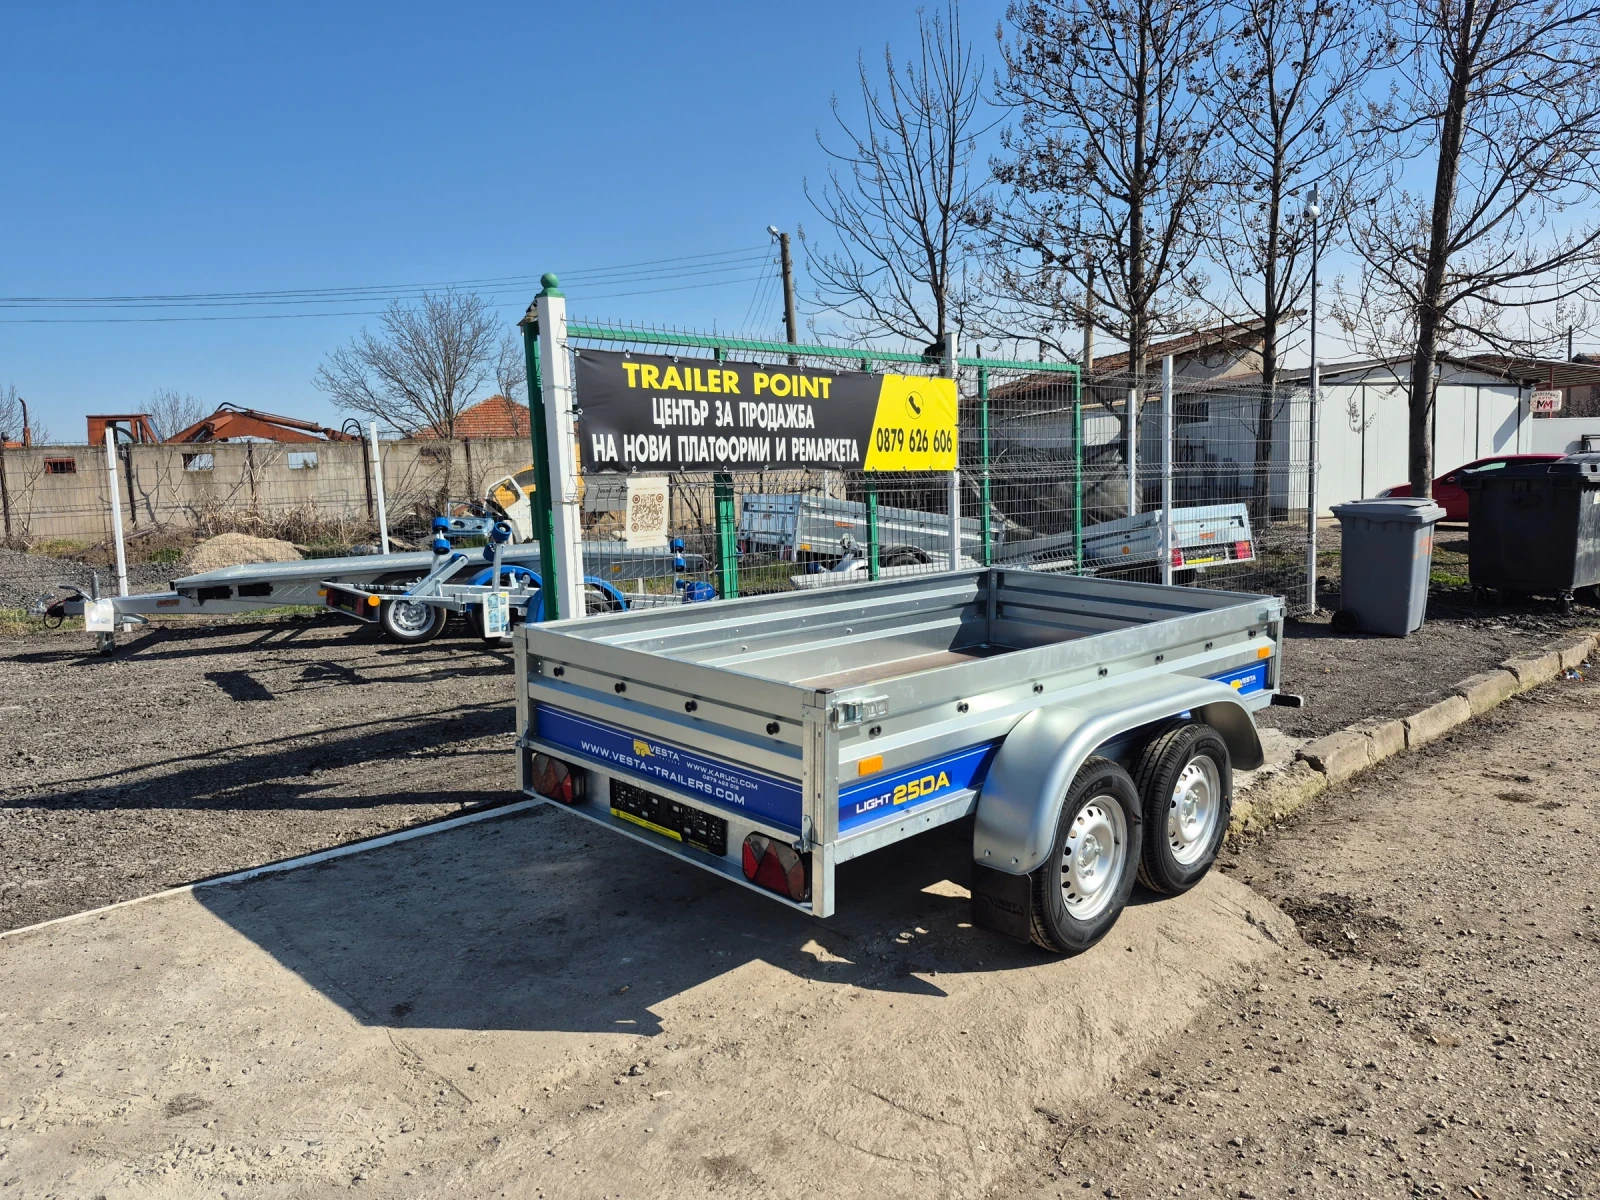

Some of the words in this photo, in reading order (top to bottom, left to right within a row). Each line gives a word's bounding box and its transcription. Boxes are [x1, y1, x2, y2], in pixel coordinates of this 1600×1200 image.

[622, 362, 741, 394] TRAILER
[753, 372, 832, 399] POINT
[652, 397, 709, 428] ЦЕНТЪР
[715, 400, 734, 427] ЗА
[739, 401, 815, 431] ПРОДАЖБА
[592, 433, 619, 462] НА
[623, 433, 671, 462] НОВИ
[677, 435, 770, 462] ПЛАТФОРМИ
[776, 437, 786, 461] И
[792, 437, 859, 462] РЕМАРКЕТА
[876, 427, 904, 452] 0879
[909, 428, 929, 452] 626
[933, 429, 952, 453] 606
[649, 743, 680, 761] VESTA
[581, 741, 745, 806] WWW.VESTA-TRAILERS.COM
[686, 761, 758, 791] WWW.KARUCI.COM
[856, 793, 891, 814] LIGHT
[893, 771, 950, 805] 25DA
